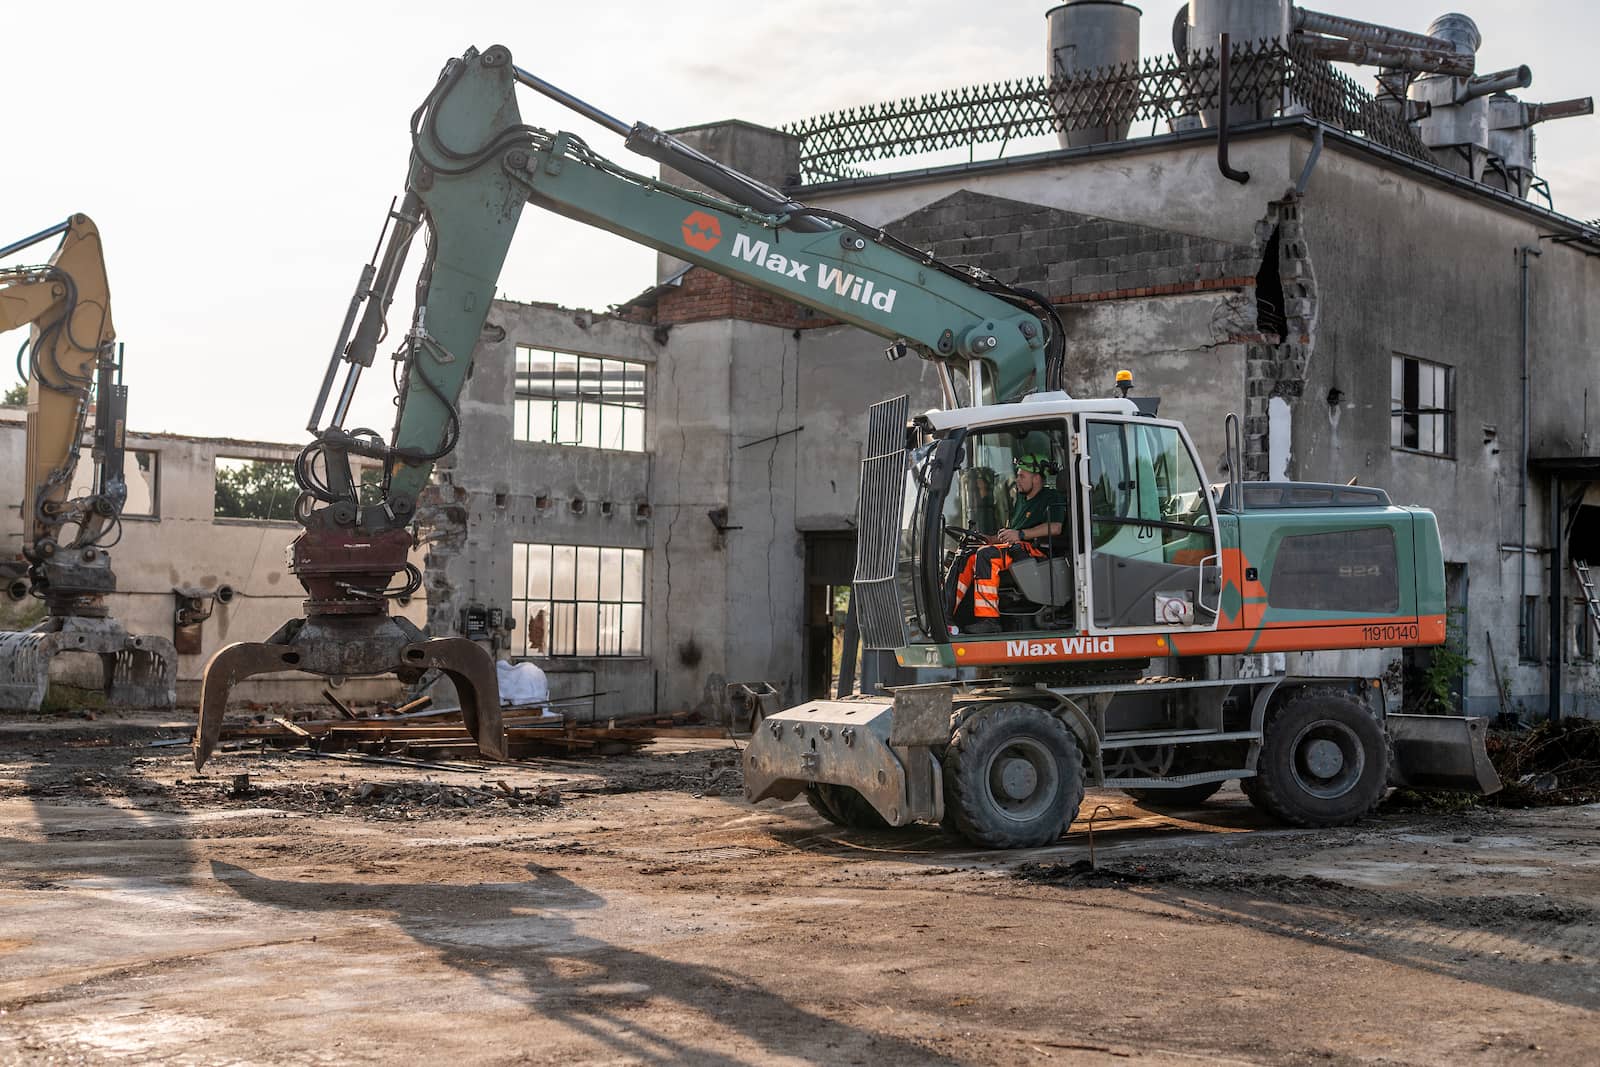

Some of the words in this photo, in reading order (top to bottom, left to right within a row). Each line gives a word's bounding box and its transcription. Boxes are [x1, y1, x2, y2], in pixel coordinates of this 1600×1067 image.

[731, 233, 811, 282] Max
[817, 263, 897, 313] Wild
[1138, 524, 1152, 539] 20
[1362, 625, 1418, 641] 11910140
[1006, 640, 1057, 657] Max
[1062, 637, 1114, 655] Wild
